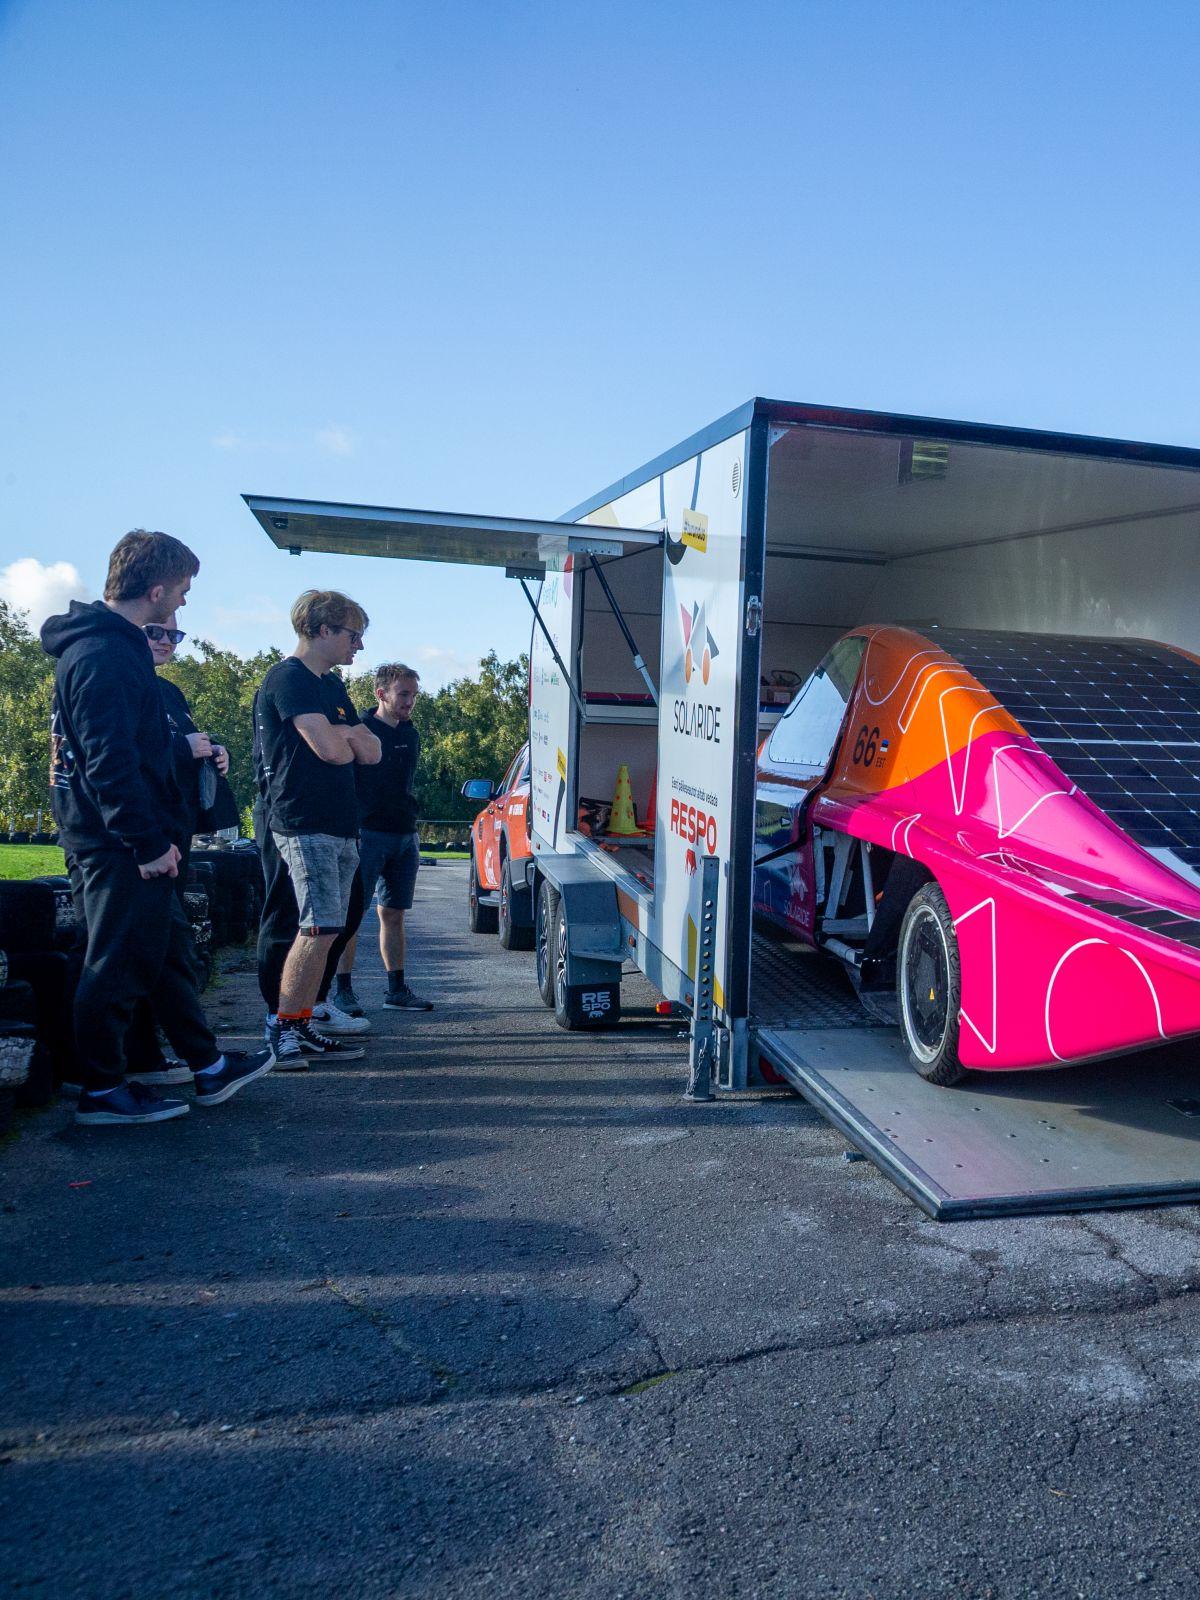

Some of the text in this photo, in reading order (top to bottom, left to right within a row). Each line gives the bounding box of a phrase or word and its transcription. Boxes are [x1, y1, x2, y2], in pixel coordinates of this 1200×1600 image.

[673, 699, 721, 744] SOLARIDE
[853, 724, 880, 768] 66
[875, 757, 887, 768] EST
[670, 798, 718, 855] RESPO
[581, 991, 611, 1004] RE
[582, 1002, 611, 1012] SPO
